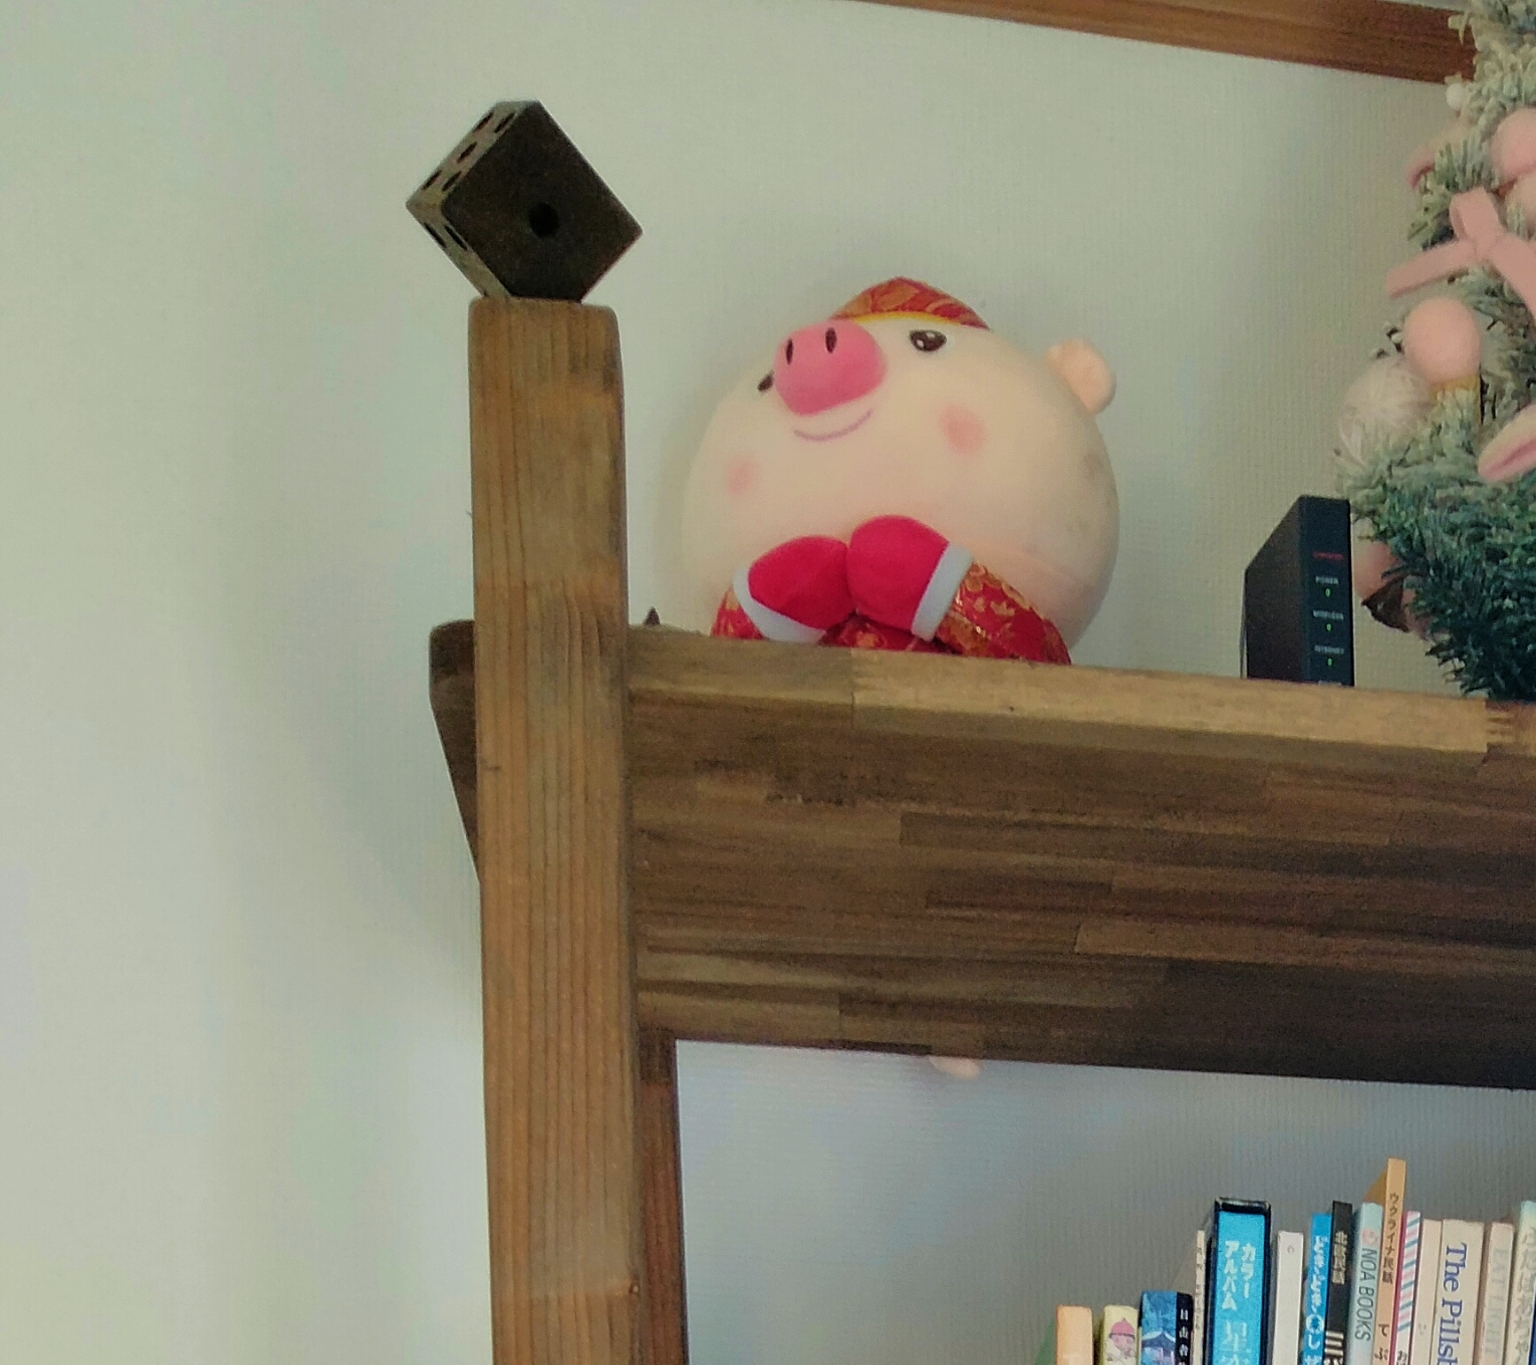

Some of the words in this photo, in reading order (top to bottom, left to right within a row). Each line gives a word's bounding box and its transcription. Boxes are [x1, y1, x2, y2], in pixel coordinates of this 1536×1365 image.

[1360, 1248, 1378, 1282] NOA
[1381, 1192, 1400, 1285] ウクライナ民話
[1221, 1240, 1240, 1312] アルバム
[1240, 1242, 1256, 1299] カラー
[1442, 1242, 1468, 1292] The
[1354, 1286, 1375, 1342] BOOKS
